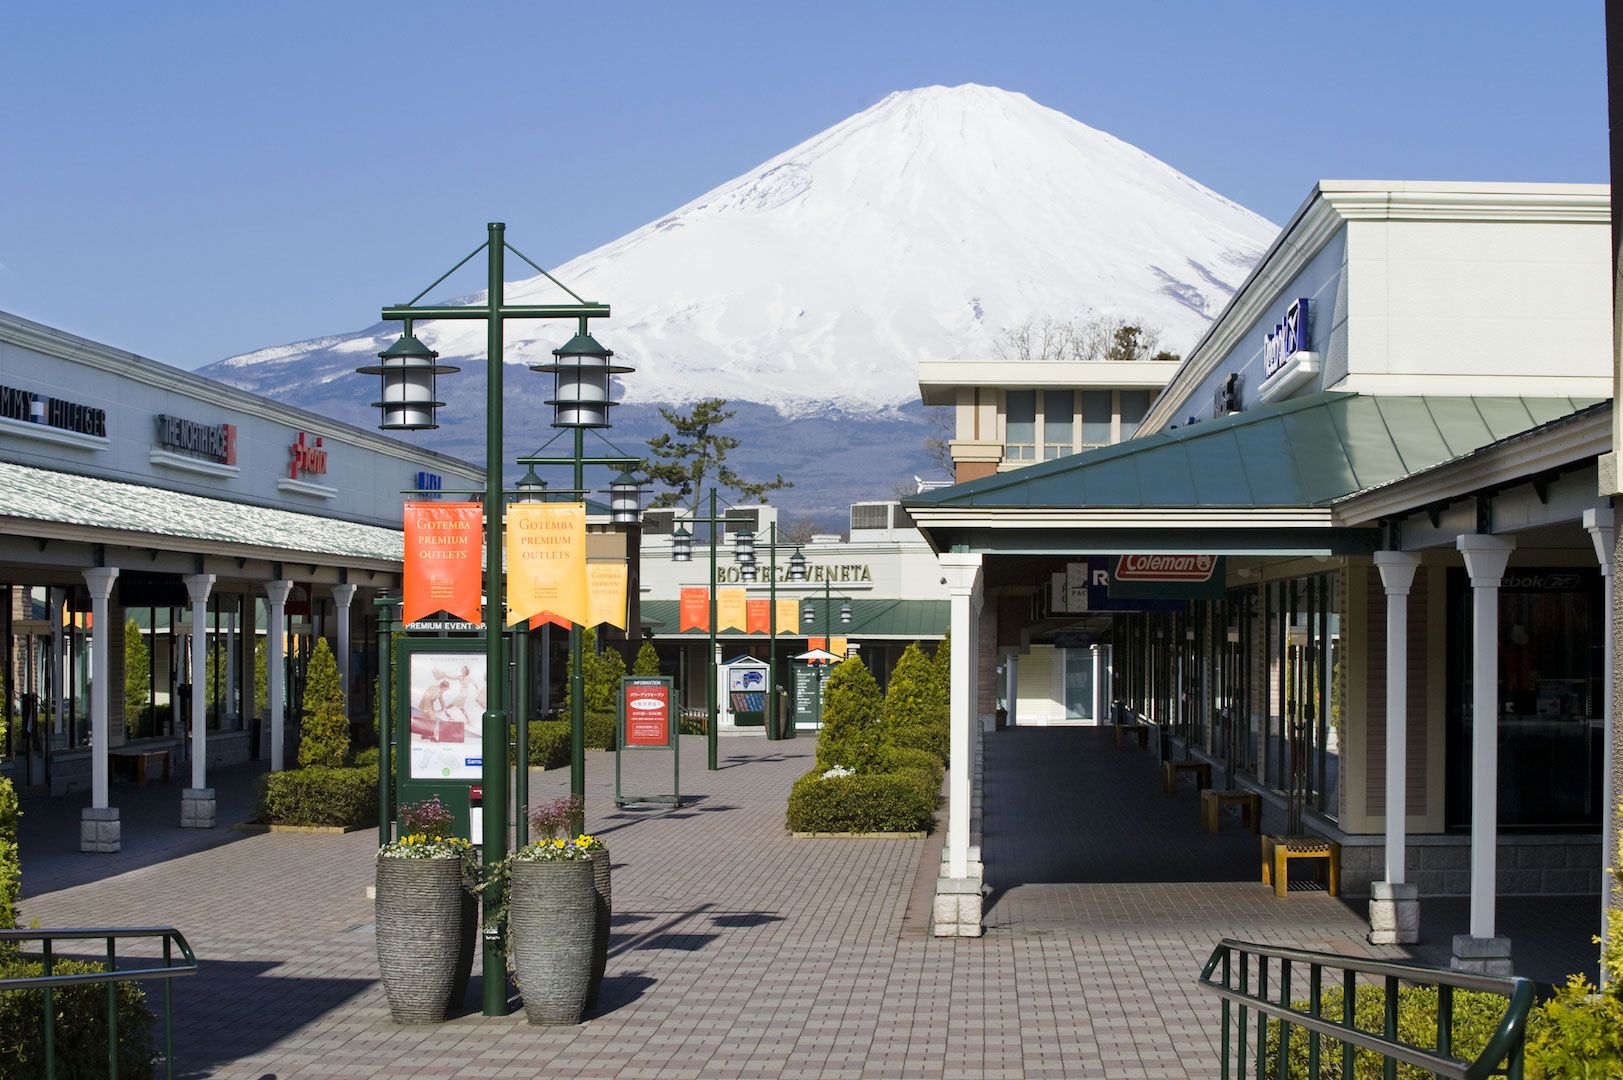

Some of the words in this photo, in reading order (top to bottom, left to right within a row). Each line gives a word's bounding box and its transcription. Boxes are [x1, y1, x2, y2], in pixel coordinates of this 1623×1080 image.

[49, 397, 107, 438] HILFIGER
[159, 414, 180, 446] THE
[180, 418, 208, 454] NORTH
[208, 423, 228, 458] FACE
[416, 517, 471, 530] GOTEMBA
[519, 518, 574, 530] GOTEMBA
[418, 535, 468, 545] PREMIUM
[521, 536, 571, 545] PREMIUM
[419, 550, 467, 560] OUTLETS
[522, 551, 570, 560] OUTLETS
[1126, 555, 1198, 571] Coleman
[803, 564, 872, 583] VENETA
[405, 622, 442, 630] PREMIUM
[445, 622, 473, 630] EVENT
